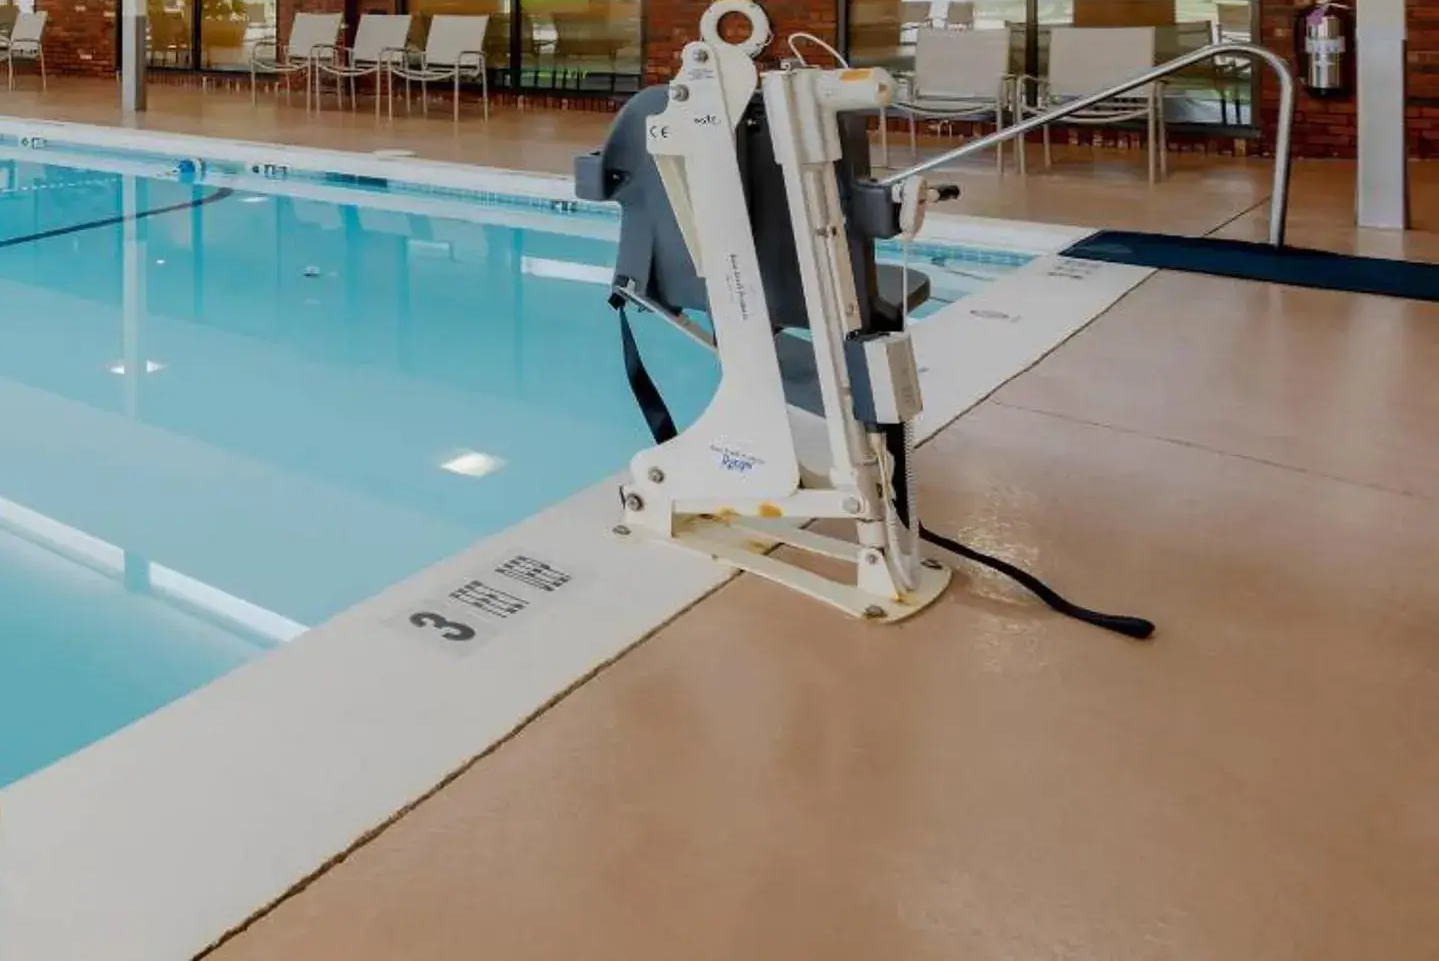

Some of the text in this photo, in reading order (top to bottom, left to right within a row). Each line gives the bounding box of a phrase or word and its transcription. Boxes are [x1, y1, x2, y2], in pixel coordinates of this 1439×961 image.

[409, 554, 573, 642] 3 FEET DEEP
